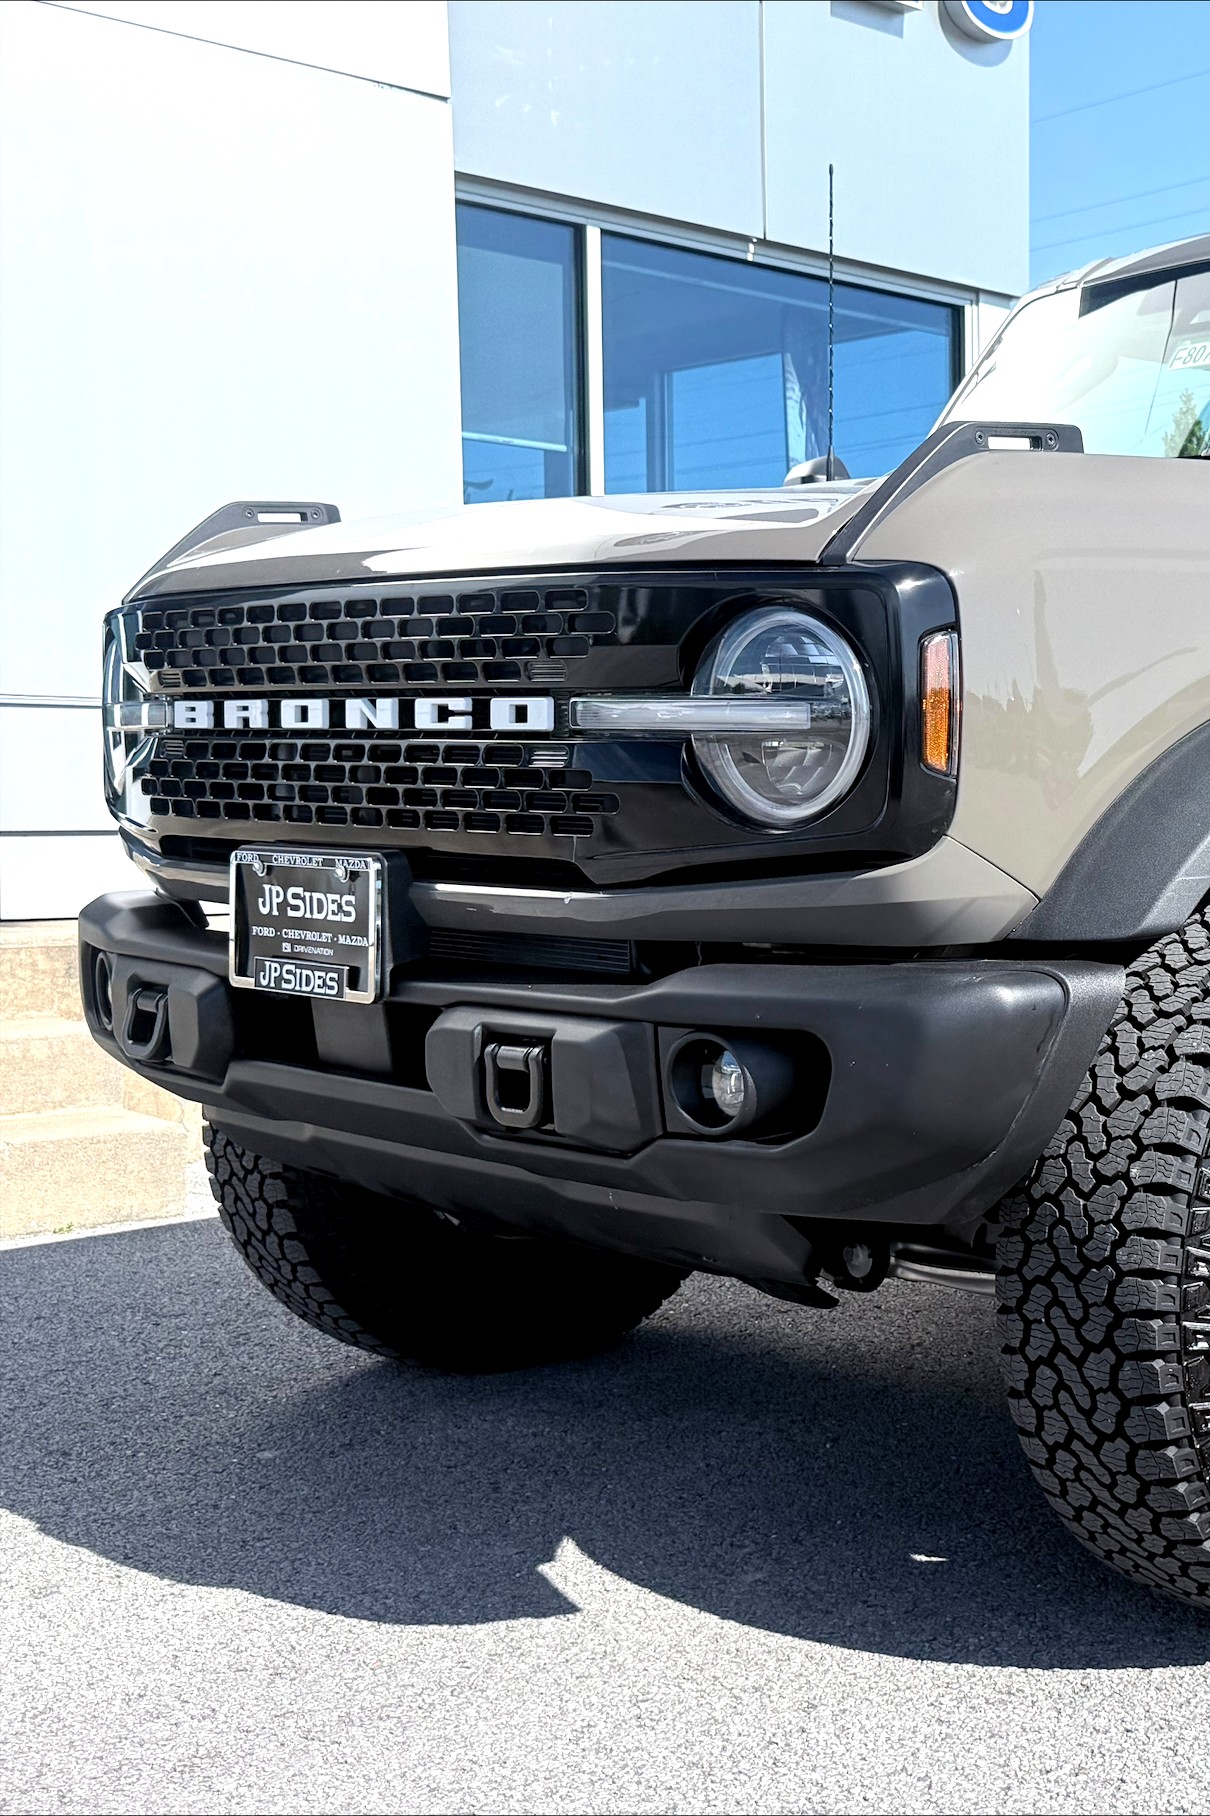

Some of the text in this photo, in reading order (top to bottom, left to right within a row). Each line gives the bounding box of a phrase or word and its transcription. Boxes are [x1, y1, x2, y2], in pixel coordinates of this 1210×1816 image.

[174, 695, 554, 732] BRONCO
[236, 852, 367, 870] FORD CHEVROLET MAZDA
[258, 884, 357, 923] JP SIDES
[252, 926, 369, 947] FORD CHEVROLET MAZDA
[259, 961, 339, 995] JP SIDES
